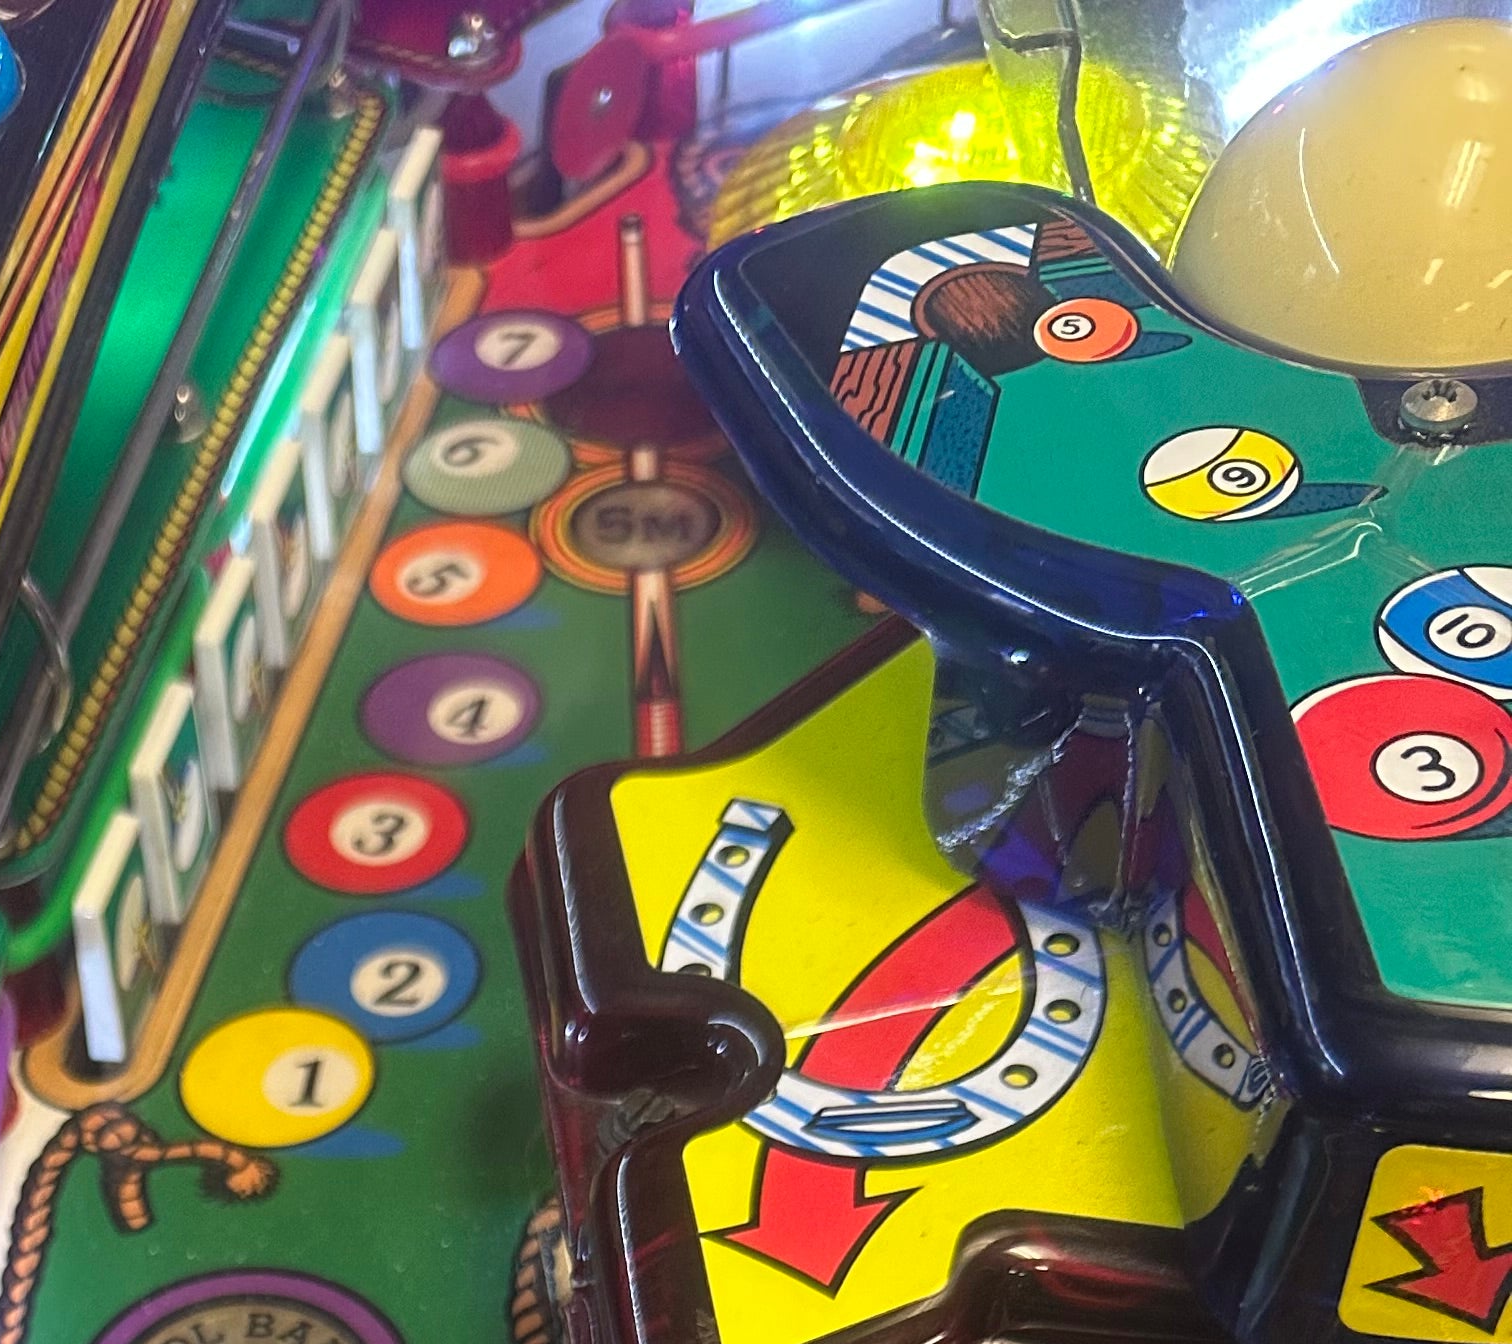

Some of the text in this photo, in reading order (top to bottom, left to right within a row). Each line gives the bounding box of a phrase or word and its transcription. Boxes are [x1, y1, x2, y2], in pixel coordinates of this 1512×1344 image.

[1057, 316, 1086, 339] 5
[500, 331, 537, 365] 7
[442, 434, 502, 467] 6
[1229, 466, 1261, 491] 9
[596, 505, 692, 543] 5M
[404, 563, 468, 598] 5
[1436, 613, 1496, 649] 10
[445, 694, 492, 738] 4
[1400, 745, 1457, 793] 3
[351, 811, 408, 859] 3
[374, 960, 420, 1008] 2
[287, 1057, 326, 1109] 1
